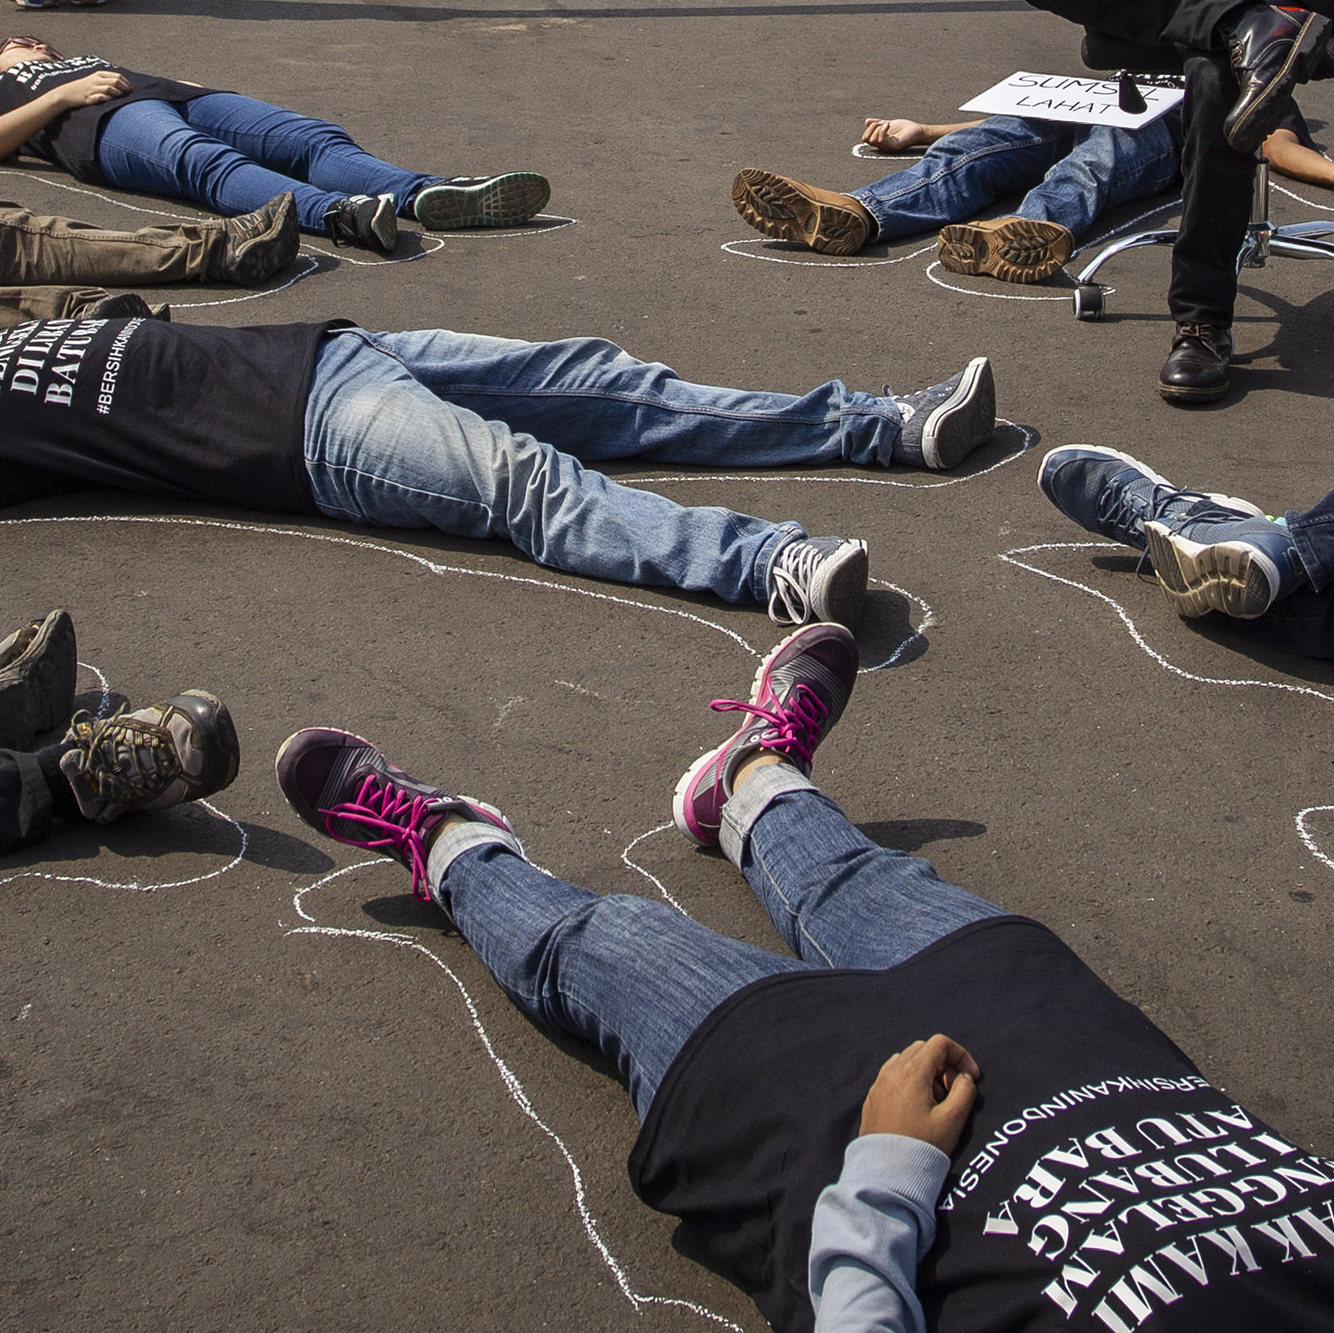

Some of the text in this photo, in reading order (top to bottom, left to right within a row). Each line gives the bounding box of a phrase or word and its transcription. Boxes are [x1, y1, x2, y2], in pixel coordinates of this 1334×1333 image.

[1008, 74, 1160, 102] SUMSL
[1016, 95, 1119, 115] LAHAT
[10, 356, 45, 395] DI
[938, 1075, 1212, 1212] ERSIHKANINDONESIA
[983, 1104, 1254, 1236] ATU BARA
[1027, 1142, 1267, 1261] LUBANG
[1092, 1224, 1262, 1333] KAMI
